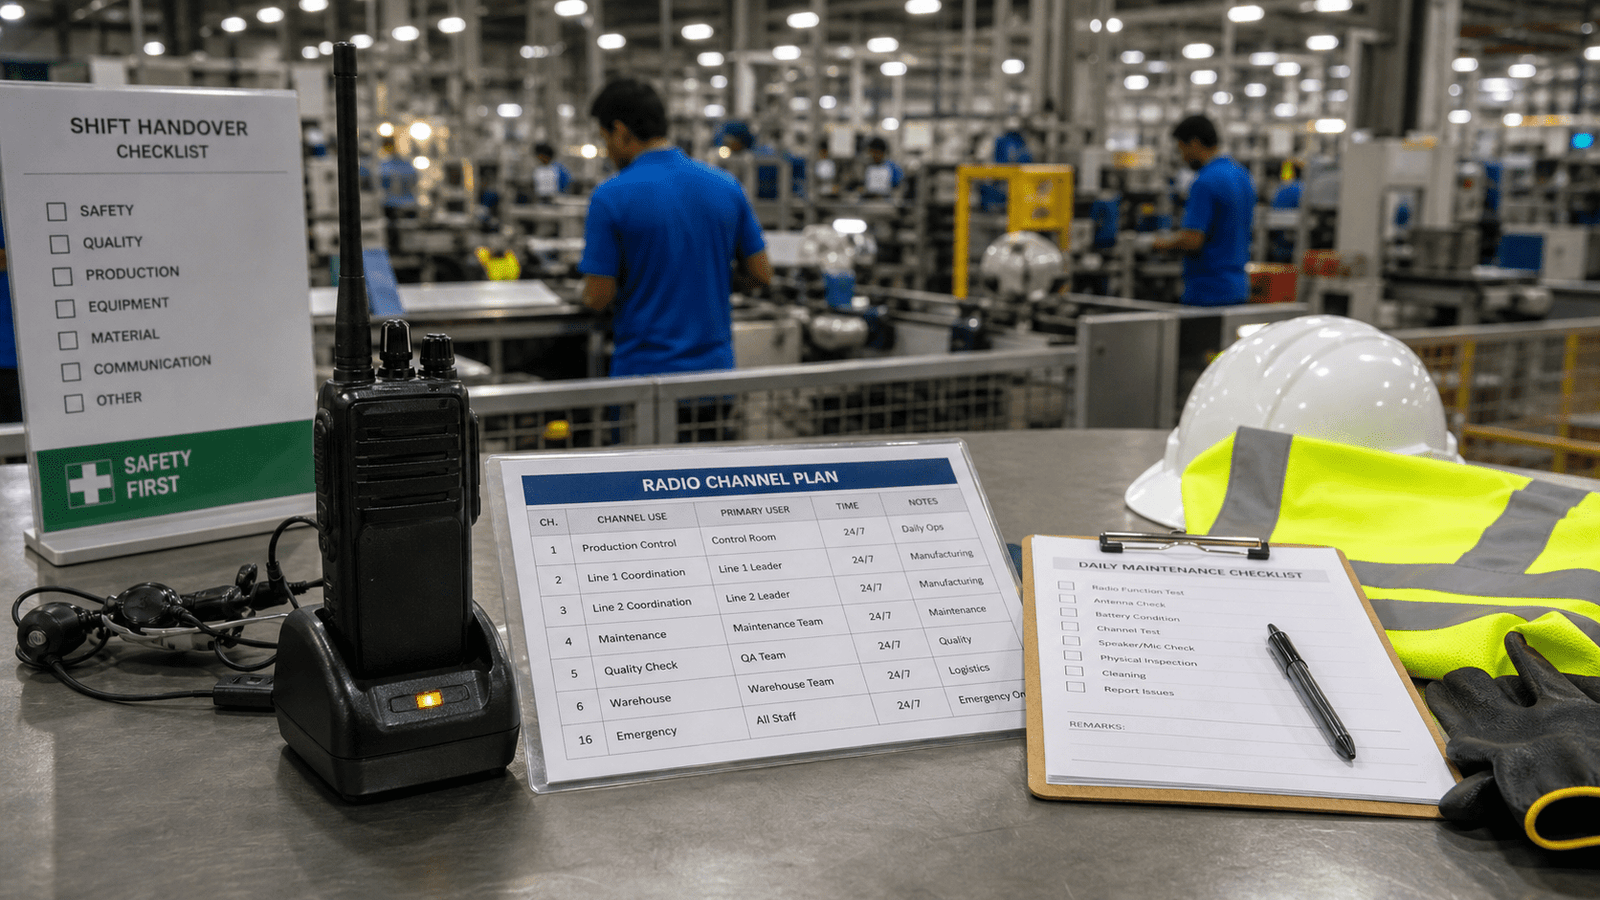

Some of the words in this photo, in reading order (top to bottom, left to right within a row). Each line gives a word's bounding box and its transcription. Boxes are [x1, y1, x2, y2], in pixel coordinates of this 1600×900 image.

[71, 117, 130, 134] SHIFT
[138, 119, 247, 136] HANDOVER
[117, 144, 208, 158] CHECKLIST
[80, 205, 133, 217] SAFETY
[83, 236, 142, 250] QUALITY
[86, 266, 179, 280] PRODUCTION
[89, 297, 169, 313] EQUIPMENT
[92, 329, 160, 343] MATERIAL
[94, 355, 211, 375] COMMUNICATION
[97, 391, 142, 406] OTHER
[125, 450, 191, 474] SAFETY
[127, 475, 179, 499] FIRST
[643, 477, 700, 491] RADIO
[706, 473, 790, 488] CHANNEL
[793, 471, 838, 484] PLAN
[540, 518, 558, 526] CH.
[598, 514, 645, 523] CHANNEL
[648, 513, 667, 521] USE
[721, 508, 762, 516] PRIMARY
[766, 506, 790, 514] USER
[551, 546, 556, 554] 1
[583, 542, 637, 552] Production
[640, 539, 676, 548] Control
[712, 535, 747, 544] Control
[844, 527, 864, 536] 24/7
[902, 525, 924, 533] Daily
[926, 524, 944, 532] Ops
[555, 576, 562, 584] 2
[588, 574, 609, 582] Line
[621, 570, 685, 580] Coordination
[719, 565, 739, 573] Line
[750, 562, 781, 571] Leader
[852, 555, 873, 564] 24/7
[910, 551, 974, 560] Manufacturing
[1123, 564, 1225, 575] MAINTENANCE
[1230, 570, 1301, 578] CHECKLIST
[560, 606, 566, 614] 3
[627, 598, 691, 610] Coordination
[726, 594, 746, 602] Line
[749, 593, 755, 601] 2
[758, 591, 789, 600] Leader
[860, 583, 882, 592] 24/7
[919, 578, 984, 588] Manufacturing
[1096, 612, 1130, 620] Battery
[599, 632, 666, 643] Maintenance
[733, 622, 795, 632] Maintenance
[869, 612, 891, 620] 24/7
[929, 607, 986, 616] Maintenance
[1099, 640, 1161, 649] Speaker/Mic
[571, 669, 577, 678] 5
[605, 665, 642, 676] Quality
[645, 661, 678, 671] Check
[741, 654, 757, 663] QA
[878, 641, 900, 650] 24/7
[939, 636, 971, 645] Quality
[1101, 655, 1141, 663] Physical
[1145, 658, 1197, 666] Inspection
[1102, 670, 1146, 679] Cleaning
[577, 702, 583, 711] 6
[610, 696, 671, 707] Warehouse
[748, 682, 805, 693] Warehouse
[807, 679, 834, 687] Team
[888, 670, 910, 679] 24/7
[949, 665, 990, 675] Logistics
[1105, 686, 1139, 694] Report
[579, 735, 592, 745] 16
[617, 728, 676, 740] Emergency
[757, 715, 770, 724] All
[772, 712, 796, 722] Staff
[897, 700, 920, 709] 24/7
[959, 694, 1010, 704] Emergency
[1012, 690, 1026, 699] On
[1069, 721, 1125, 731] REMARKS:
